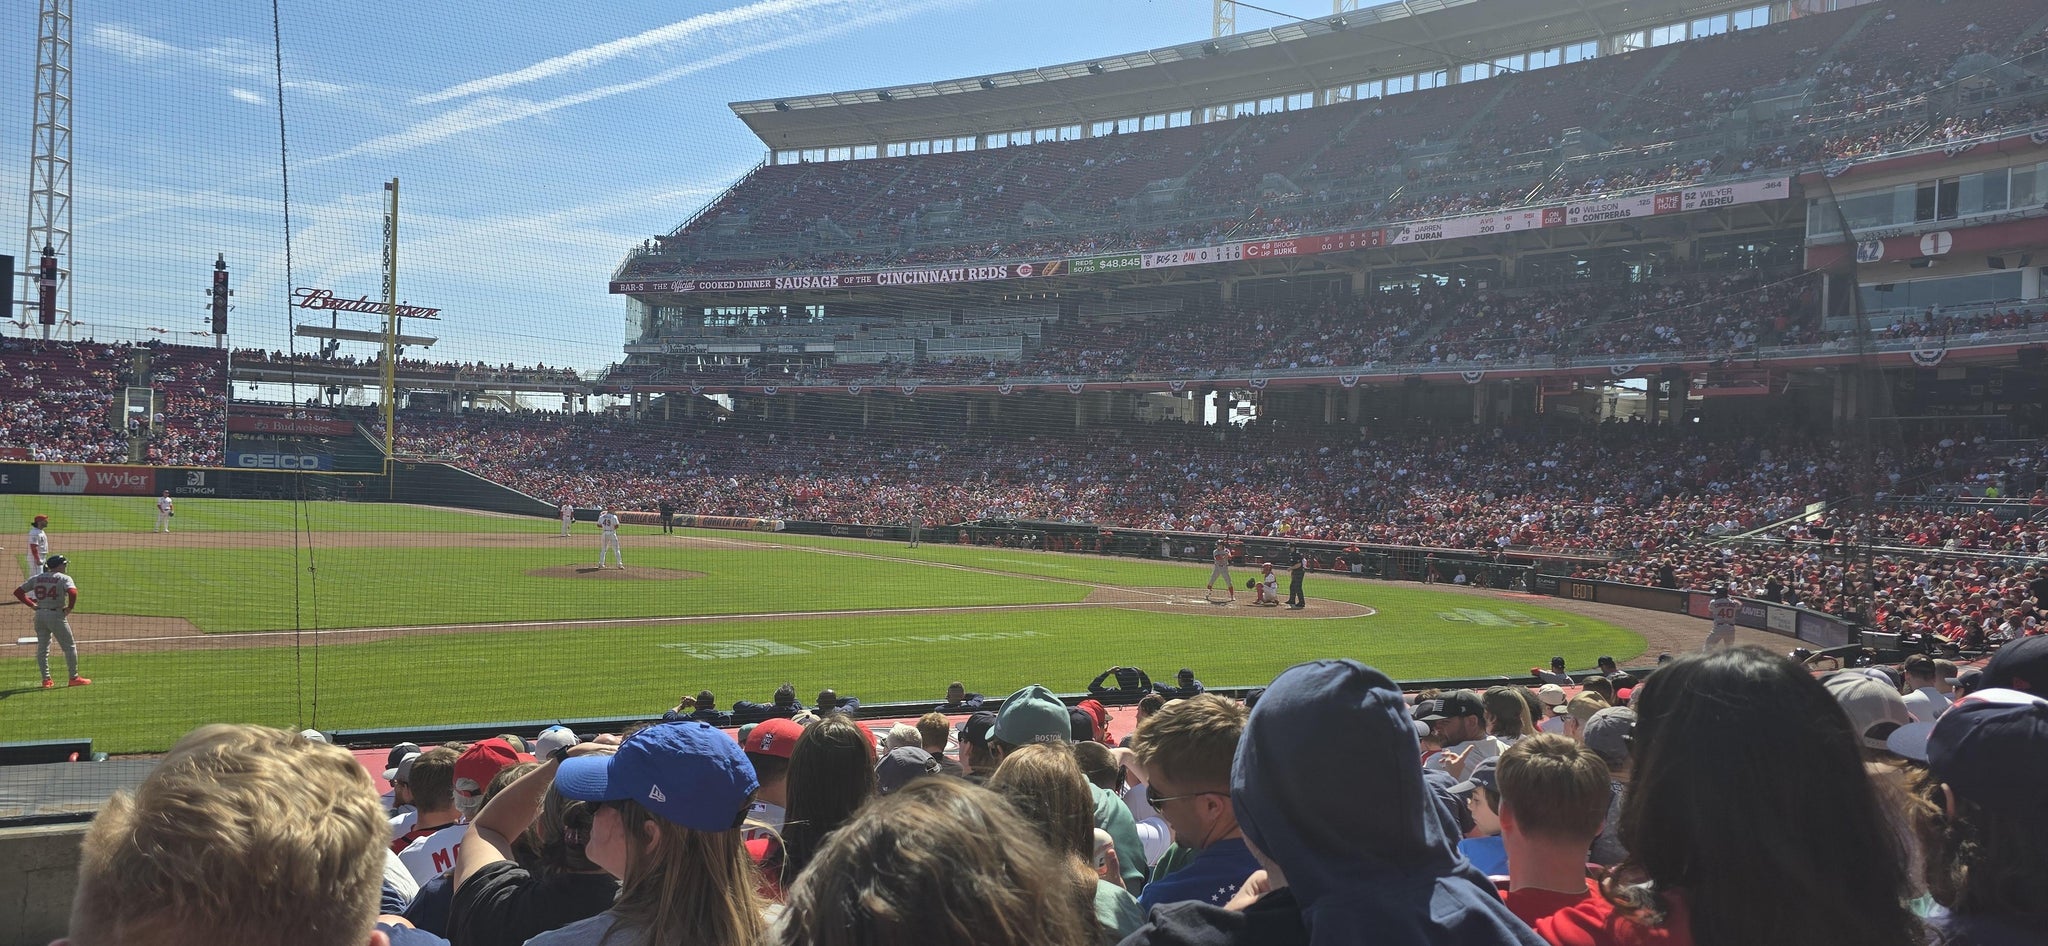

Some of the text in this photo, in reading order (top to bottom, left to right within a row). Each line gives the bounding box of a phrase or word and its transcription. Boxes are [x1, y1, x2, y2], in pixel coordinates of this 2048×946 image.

[1684, 192, 1697, 201] 52
[1699, 187, 1733, 199] WILYER
[1656, 195, 1680, 204] IN THE
[1699, 196, 1734, 208] ABREU
[1568, 206, 1580, 215] 40
[1582, 202, 1619, 213] WILLSON
[1658, 201, 1677, 210] HOLE
[1582, 209, 1631, 222] CONTRERAS
[383, 215, 391, 242] ROOT
[1414, 225, 1442, 234] JARREN
[1414, 232, 1443, 241] DURAN
[1273, 240, 1295, 249] BROCK
[1930, 232, 1940, 254] 1
[1234, 251, 1240, 259] 0
[1273, 247, 1297, 256] BURKE
[1857, 241, 1880, 260] 42
[1156, 254, 1178, 264] BOS 2
[1182, 250, 1207, 263] CIN 0
[1099, 257, 1141, 270] $48,845
[620, 283, 644, 292] BAR-S
[653, 282, 668, 290] THE
[699, 281, 735, 290] COOKED
[736, 279, 772, 289] DINNER
[775, 275, 839, 290] SAUSAGE
[843, 276, 855, 284] OF
[856, 275, 872, 284] THE
[877, 268, 964, 286] CINCINNATI
[968, 265, 1008, 281] REDS
[273, 421, 330, 434] Budweiser
[238, 453, 319, 469] GEICO
[95, 471, 149, 489] Wyler
[175, 486, 215, 494] BETMGM
[703, 516, 751, 527] GORILLA TAPE
[34, 585, 58, 601] 84
[1718, 608, 1734, 619] 40
[1035, 733, 1062, 742] BOSTON
